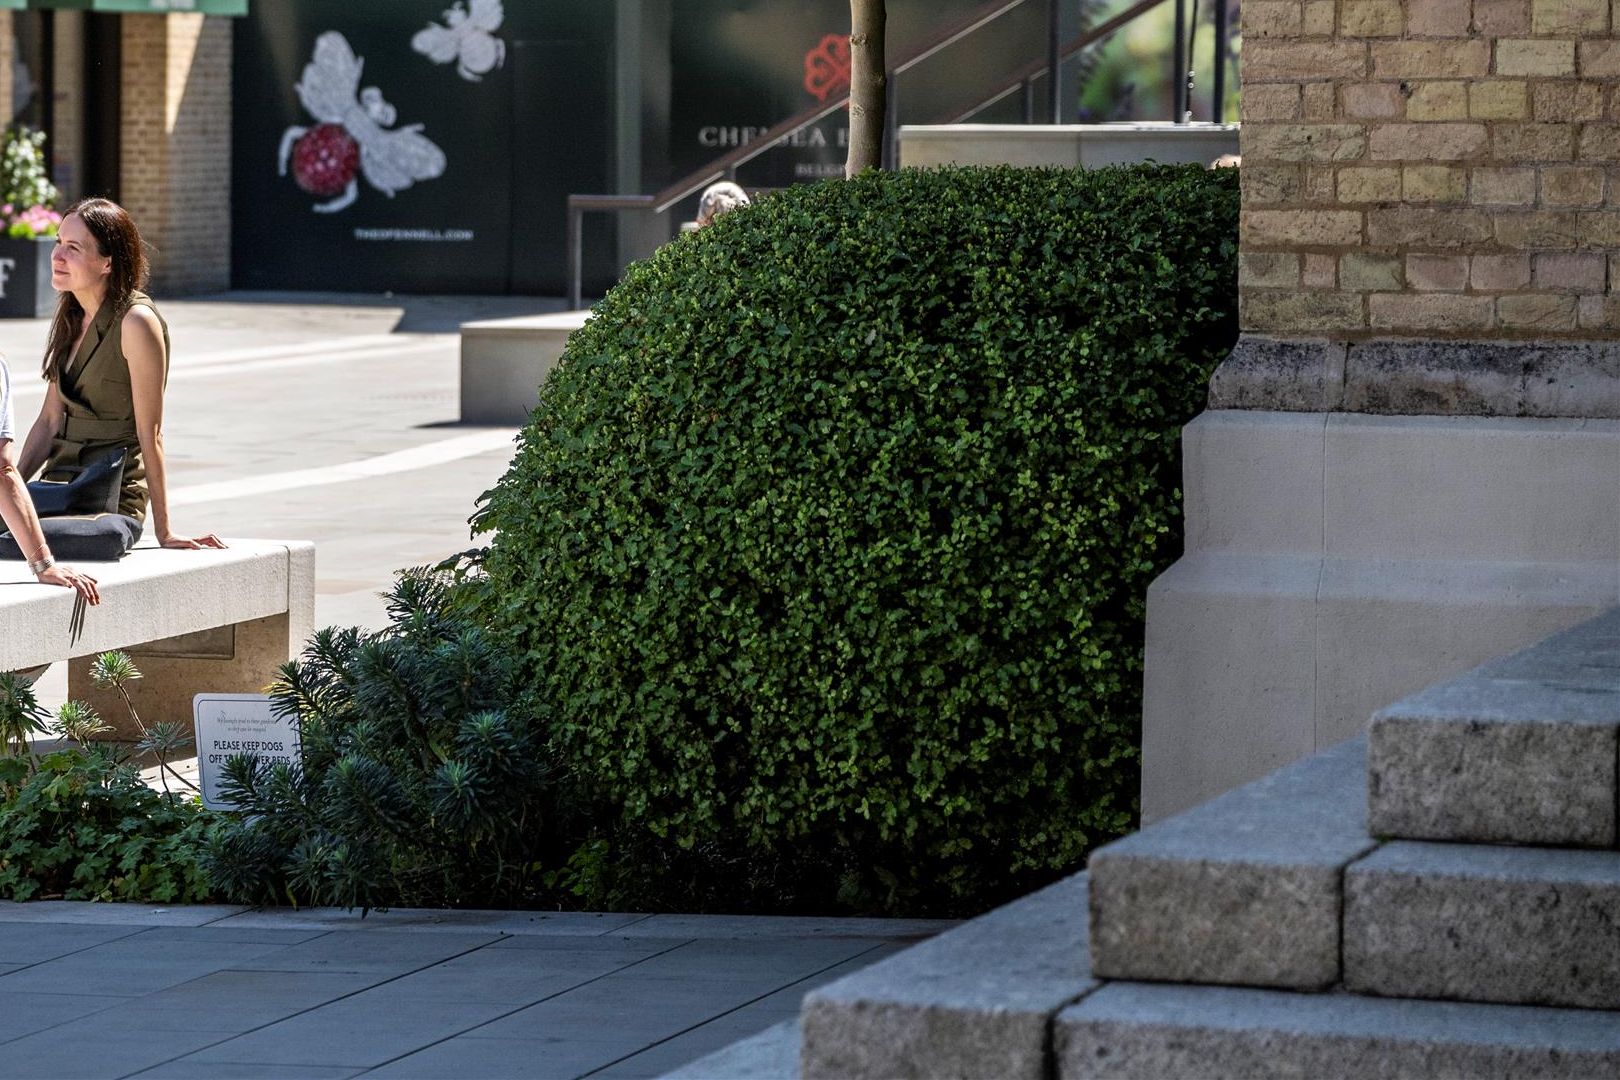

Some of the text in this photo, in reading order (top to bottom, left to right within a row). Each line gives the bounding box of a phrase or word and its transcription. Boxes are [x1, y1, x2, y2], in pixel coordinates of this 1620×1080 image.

[214, 740, 284, 752] PLEASE KEEP DOGS
[209, 754, 222, 764] OFF
